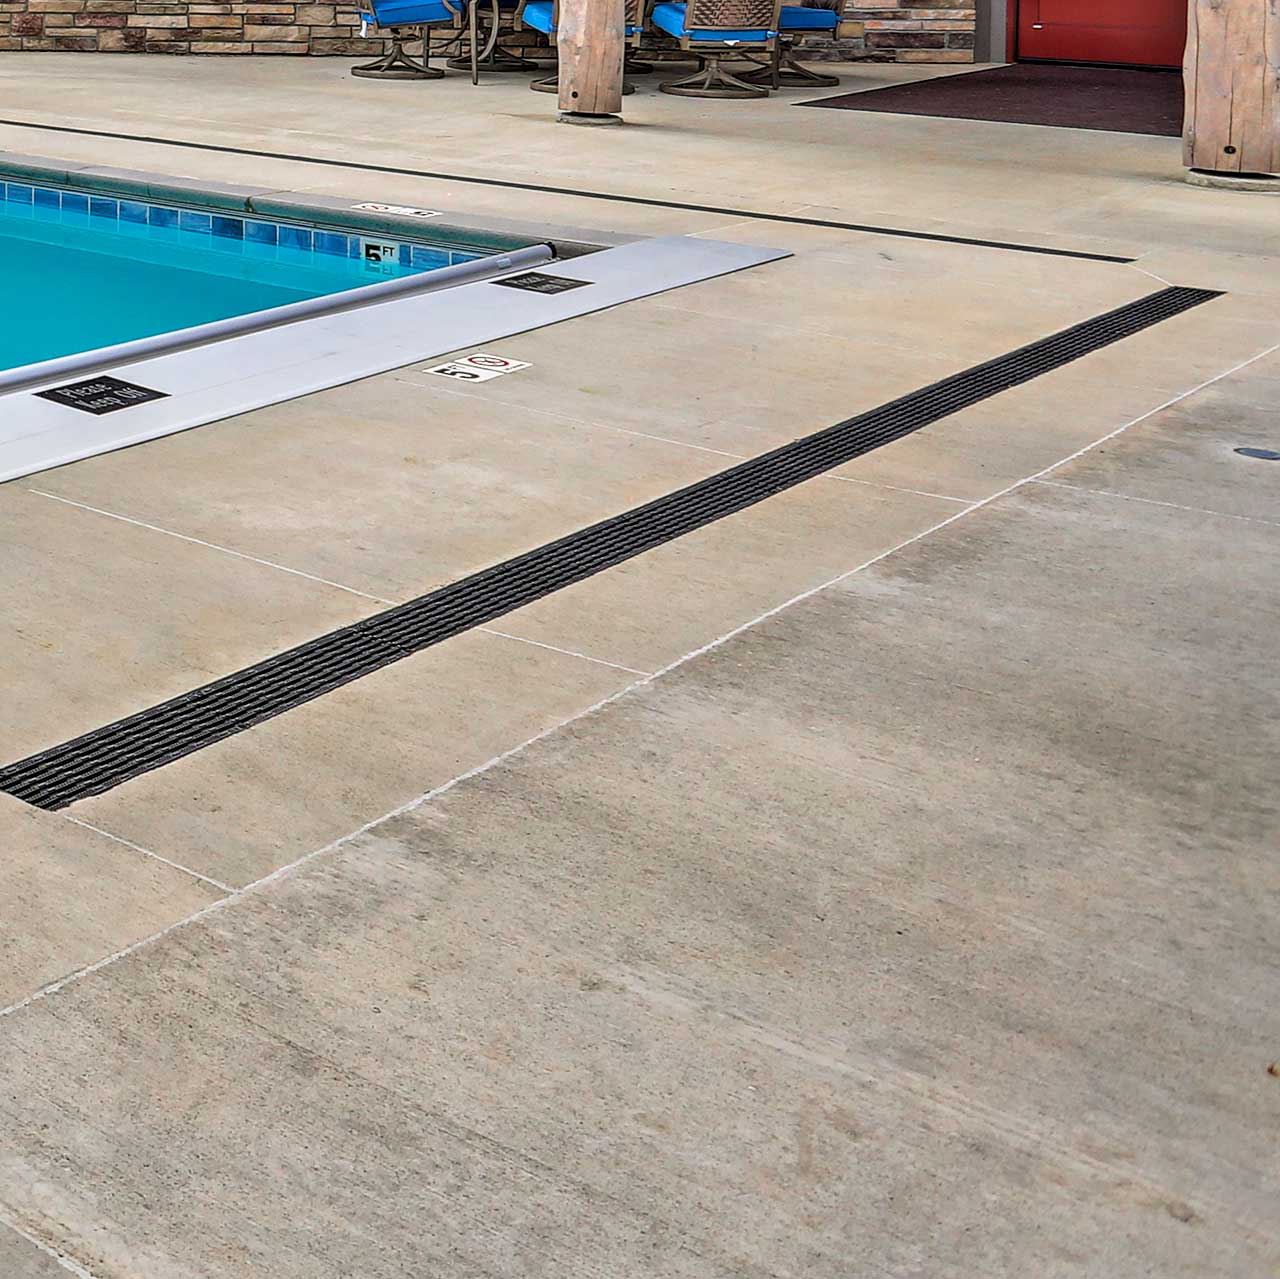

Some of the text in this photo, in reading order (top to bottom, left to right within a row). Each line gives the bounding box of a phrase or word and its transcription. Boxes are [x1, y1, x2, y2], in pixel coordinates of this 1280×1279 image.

[365, 244, 395, 262] 5 FT
[433, 368, 481, 379] 5
[55, 383, 112, 399] Please
